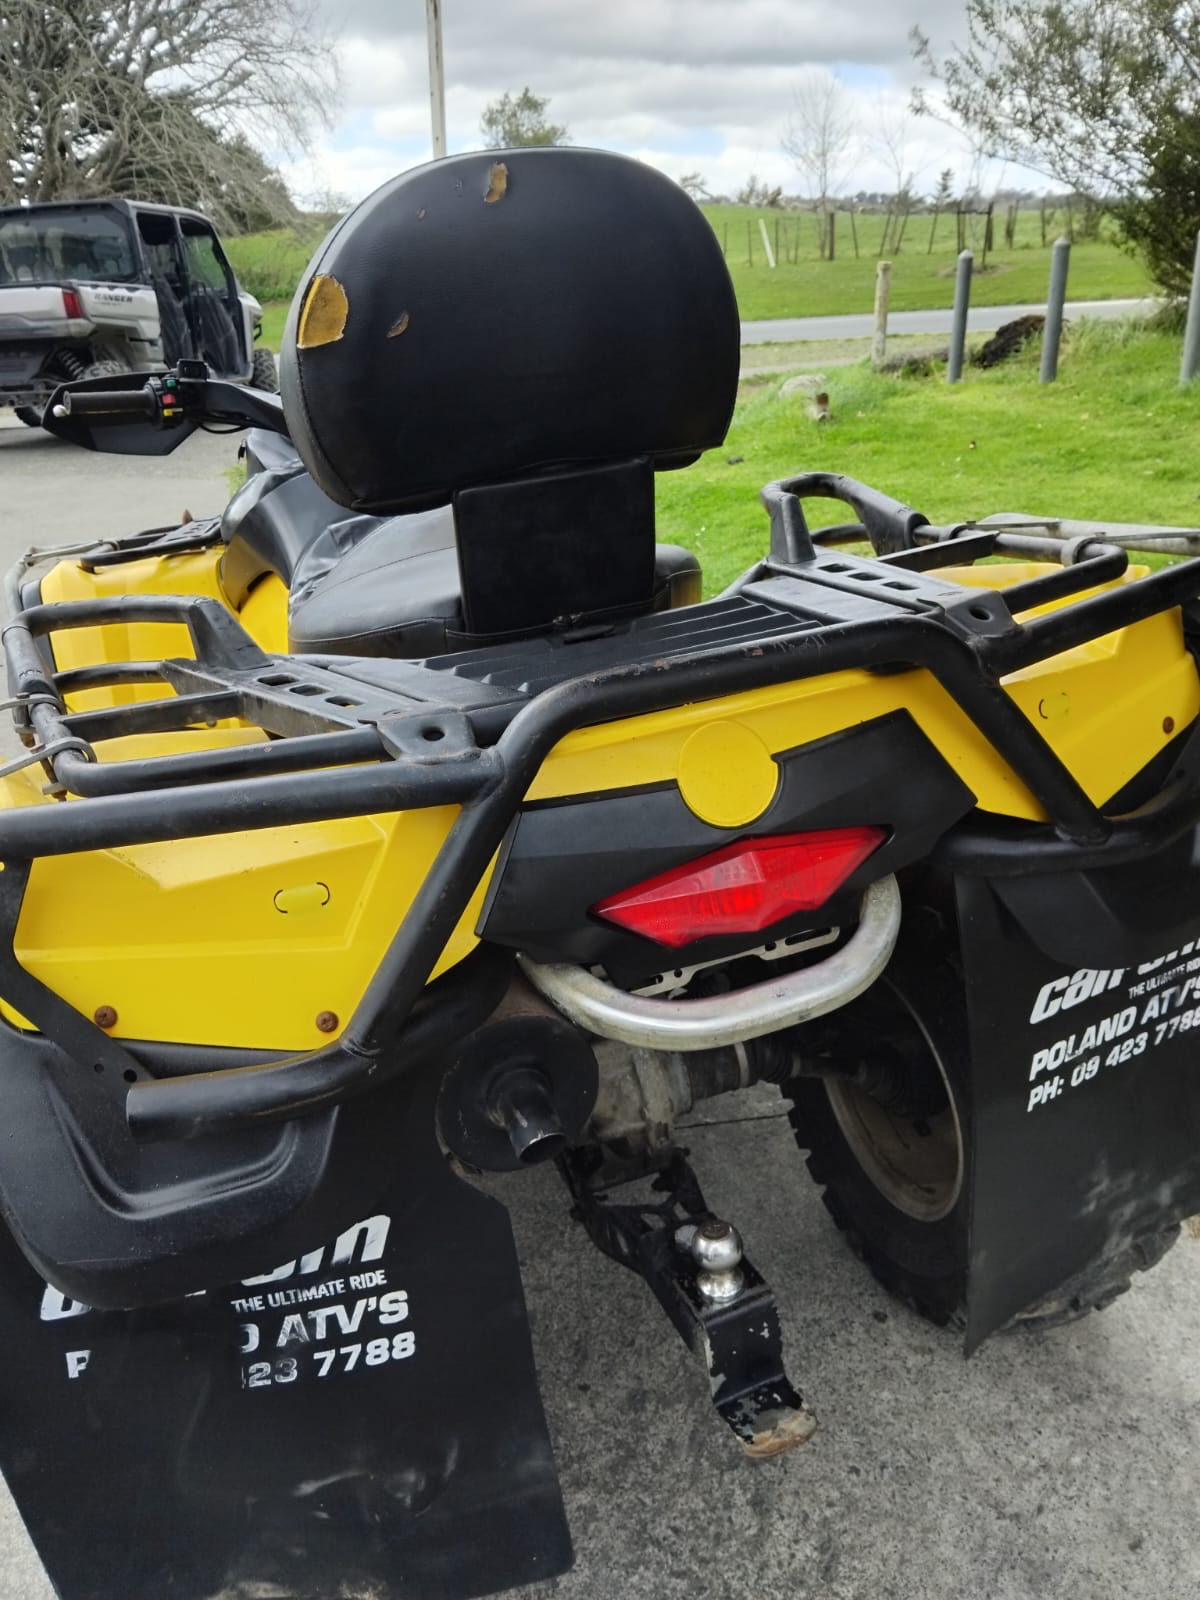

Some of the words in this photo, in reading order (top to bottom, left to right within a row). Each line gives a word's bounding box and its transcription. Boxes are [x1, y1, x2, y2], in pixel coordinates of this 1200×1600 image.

[1129, 981, 1146, 1000] THE
[1186, 957, 1200, 973] RID
[1029, 1006, 1137, 1082] POLAND
[1027, 1074, 1065, 1112] PH:
[1070, 1055, 1101, 1087] 09
[1105, 1031, 1149, 1067] 423
[230, 1296, 266, 1314] THE
[268, 1279, 347, 1307] ULTIMATE
[349, 1269, 387, 1291] RIDE
[276, 1290, 409, 1347] ATV'S
[313, 1331, 416, 1377] 7788
